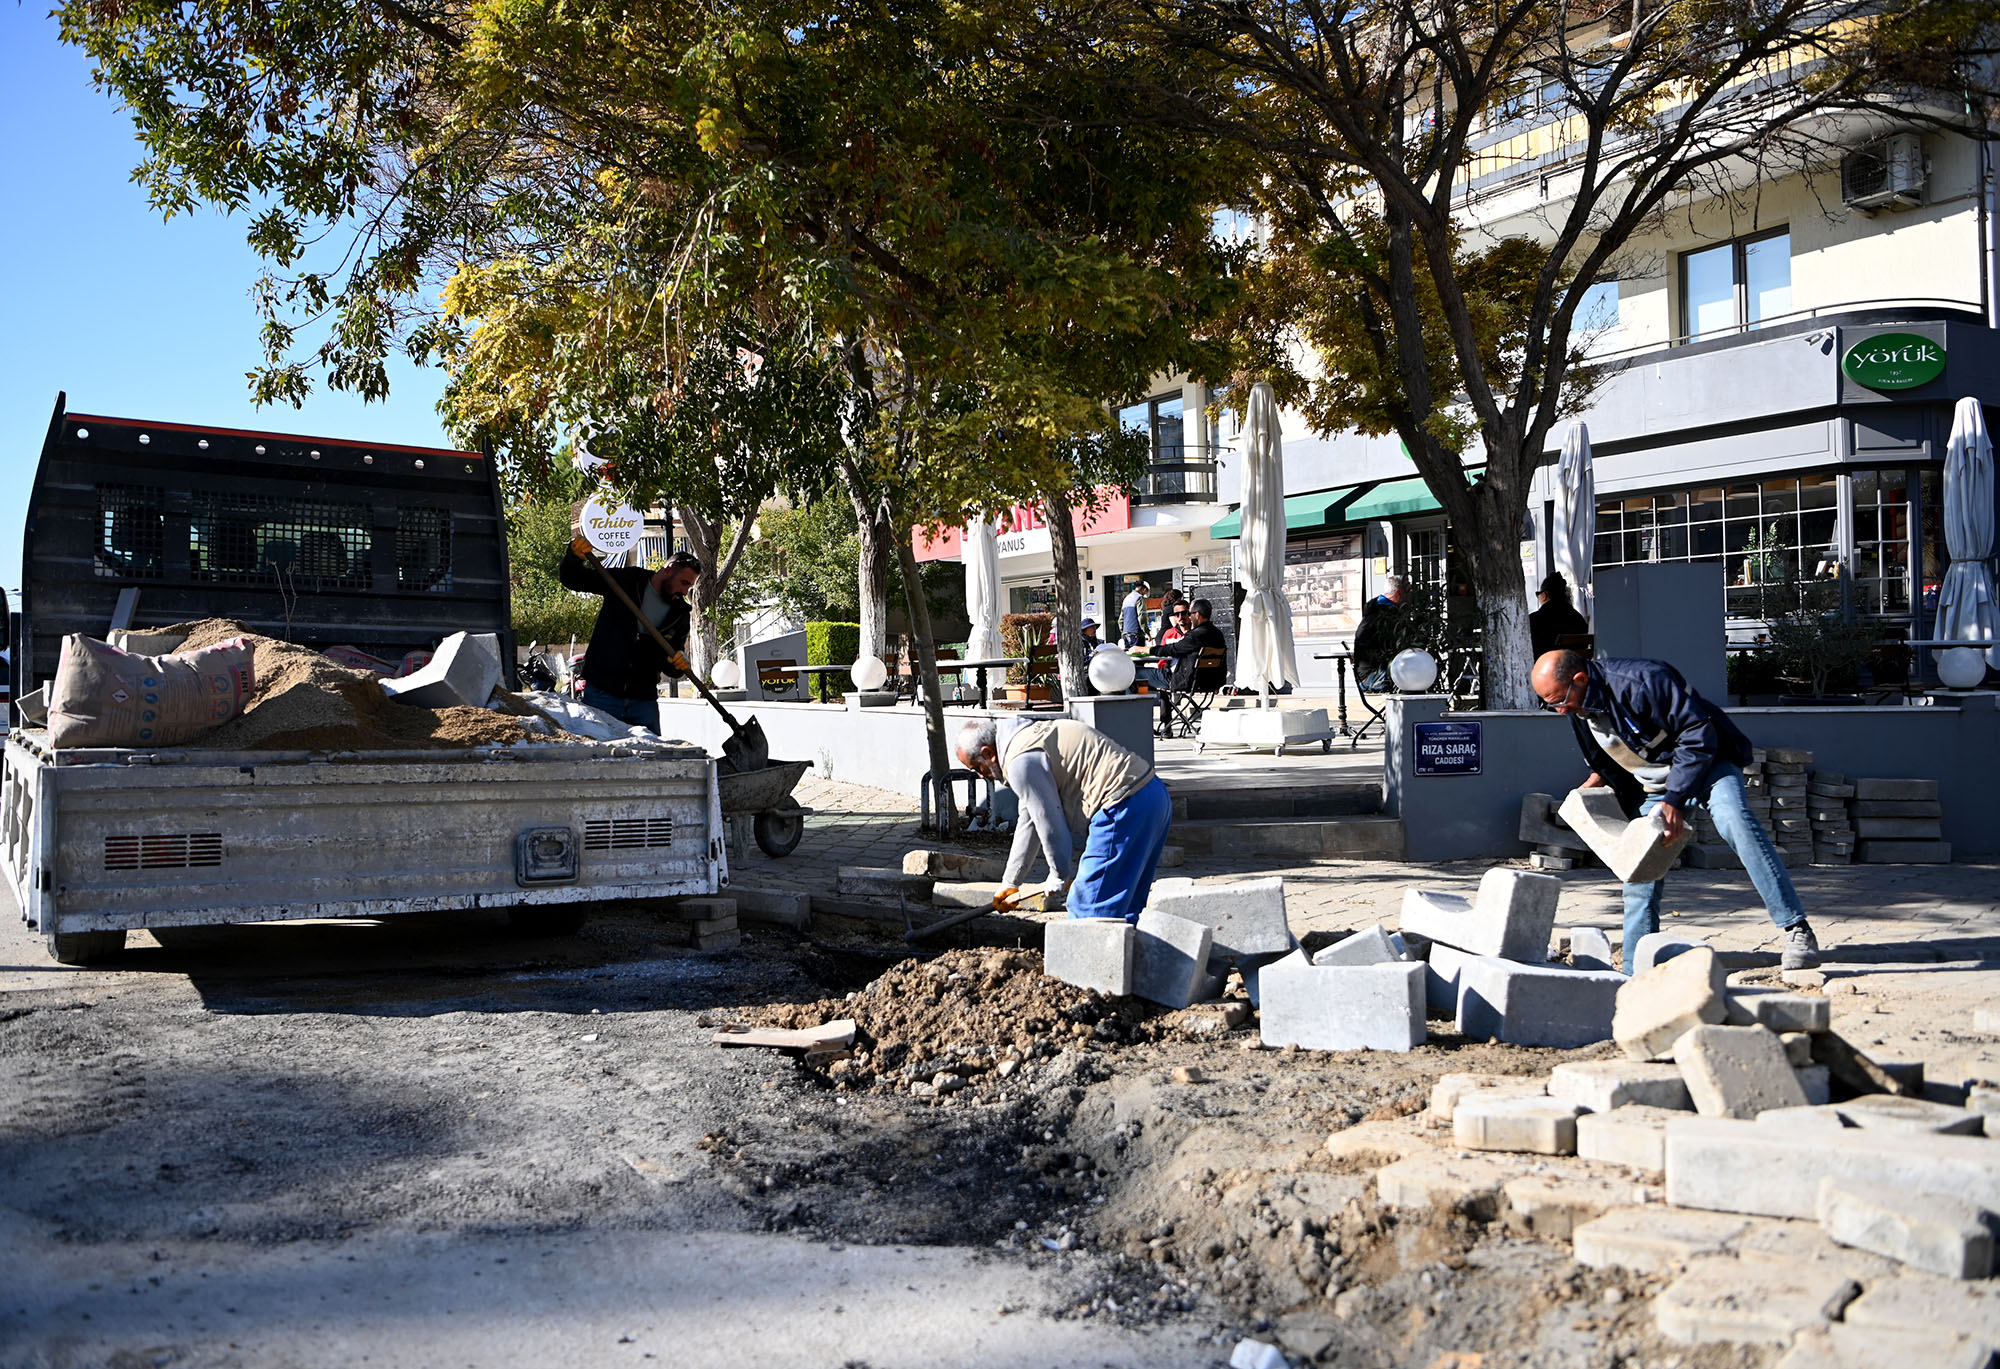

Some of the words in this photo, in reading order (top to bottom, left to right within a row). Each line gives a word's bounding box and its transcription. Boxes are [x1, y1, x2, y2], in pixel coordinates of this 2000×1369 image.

[1853, 345, 1938, 368] yörük
[589, 517, 638, 529] Tchibo
[599, 532, 630, 540] COFFEE
[997, 537, 1025, 553] YANUS
[1421, 744, 1444, 755] RIZA
[1446, 744, 1476, 756] SARAÇ
[1435, 755, 1464, 764] CADDESİ
